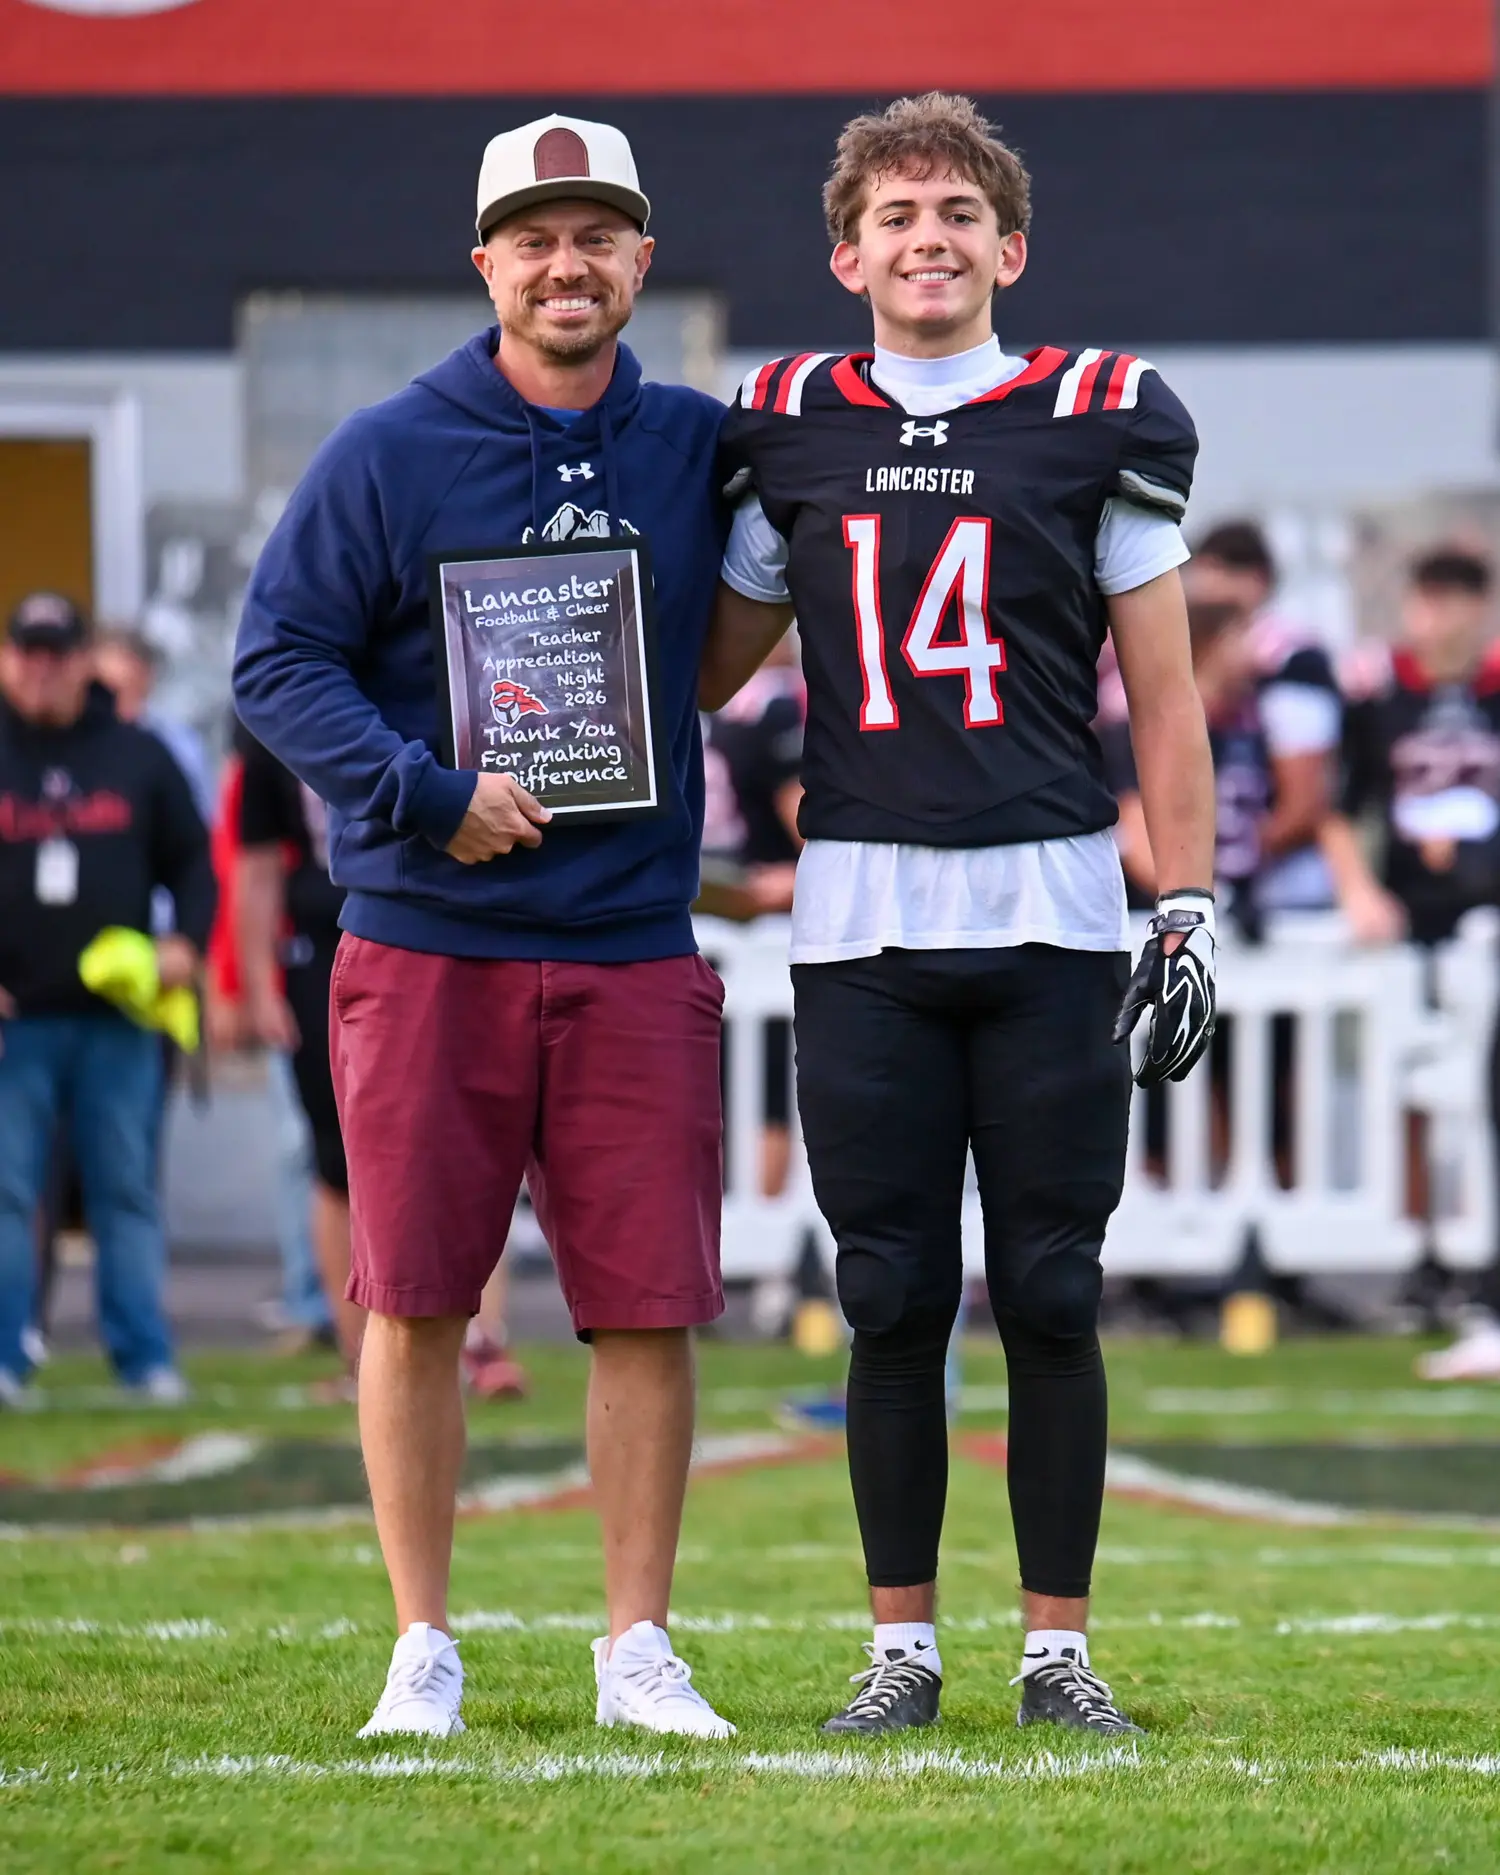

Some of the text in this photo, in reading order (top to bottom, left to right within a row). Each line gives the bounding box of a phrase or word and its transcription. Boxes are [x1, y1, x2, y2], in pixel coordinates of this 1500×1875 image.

[865, 466, 975, 495] LANCASTER
[464, 574, 614, 614] Lancaster
[475, 602, 609, 629] Football & Cheer
[842, 513, 1008, 731] 14
[528, 628, 602, 647] Teacher
[482, 650, 604, 678] Appreciation
[556, 672, 605, 691] Night
[564, 690, 607, 707] 2026
[483, 720, 617, 746] Thank You
[480, 742, 622, 768] For making
